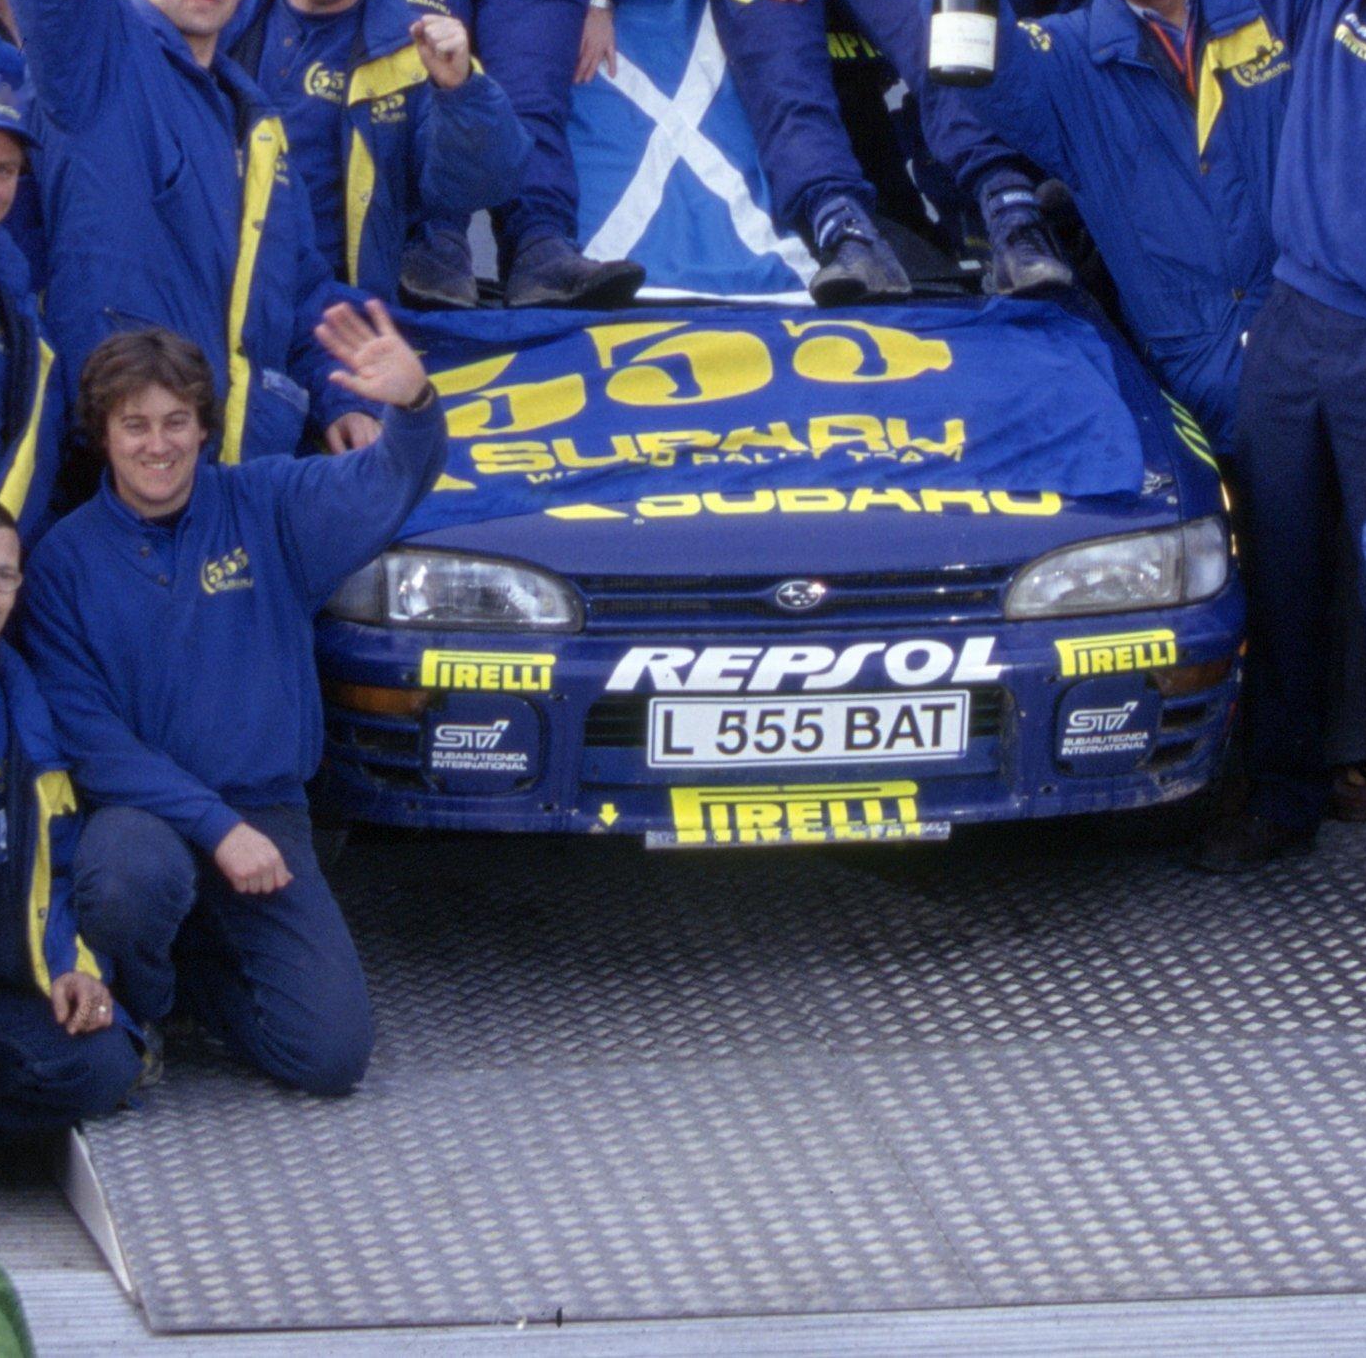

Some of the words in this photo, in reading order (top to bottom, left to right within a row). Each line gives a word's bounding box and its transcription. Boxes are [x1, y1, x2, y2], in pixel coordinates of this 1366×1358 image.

[636, 488, 1062, 518] SUBARU
[206, 547, 250, 583] 555
[420, 649, 557, 691] PIRELLI
[605, 637, 1003, 692] REPSOL
[1054, 628, 1178, 677] PIRELLI
[662, 708, 694, 757] L
[715, 705, 824, 755] 555
[844, 702, 956, 752] BAT
[1061, 741, 1148, 756] INTERNATIONAL
[432, 760, 528, 771] INTERNATIONAL
[670, 779, 919, 843] PIRELLI
